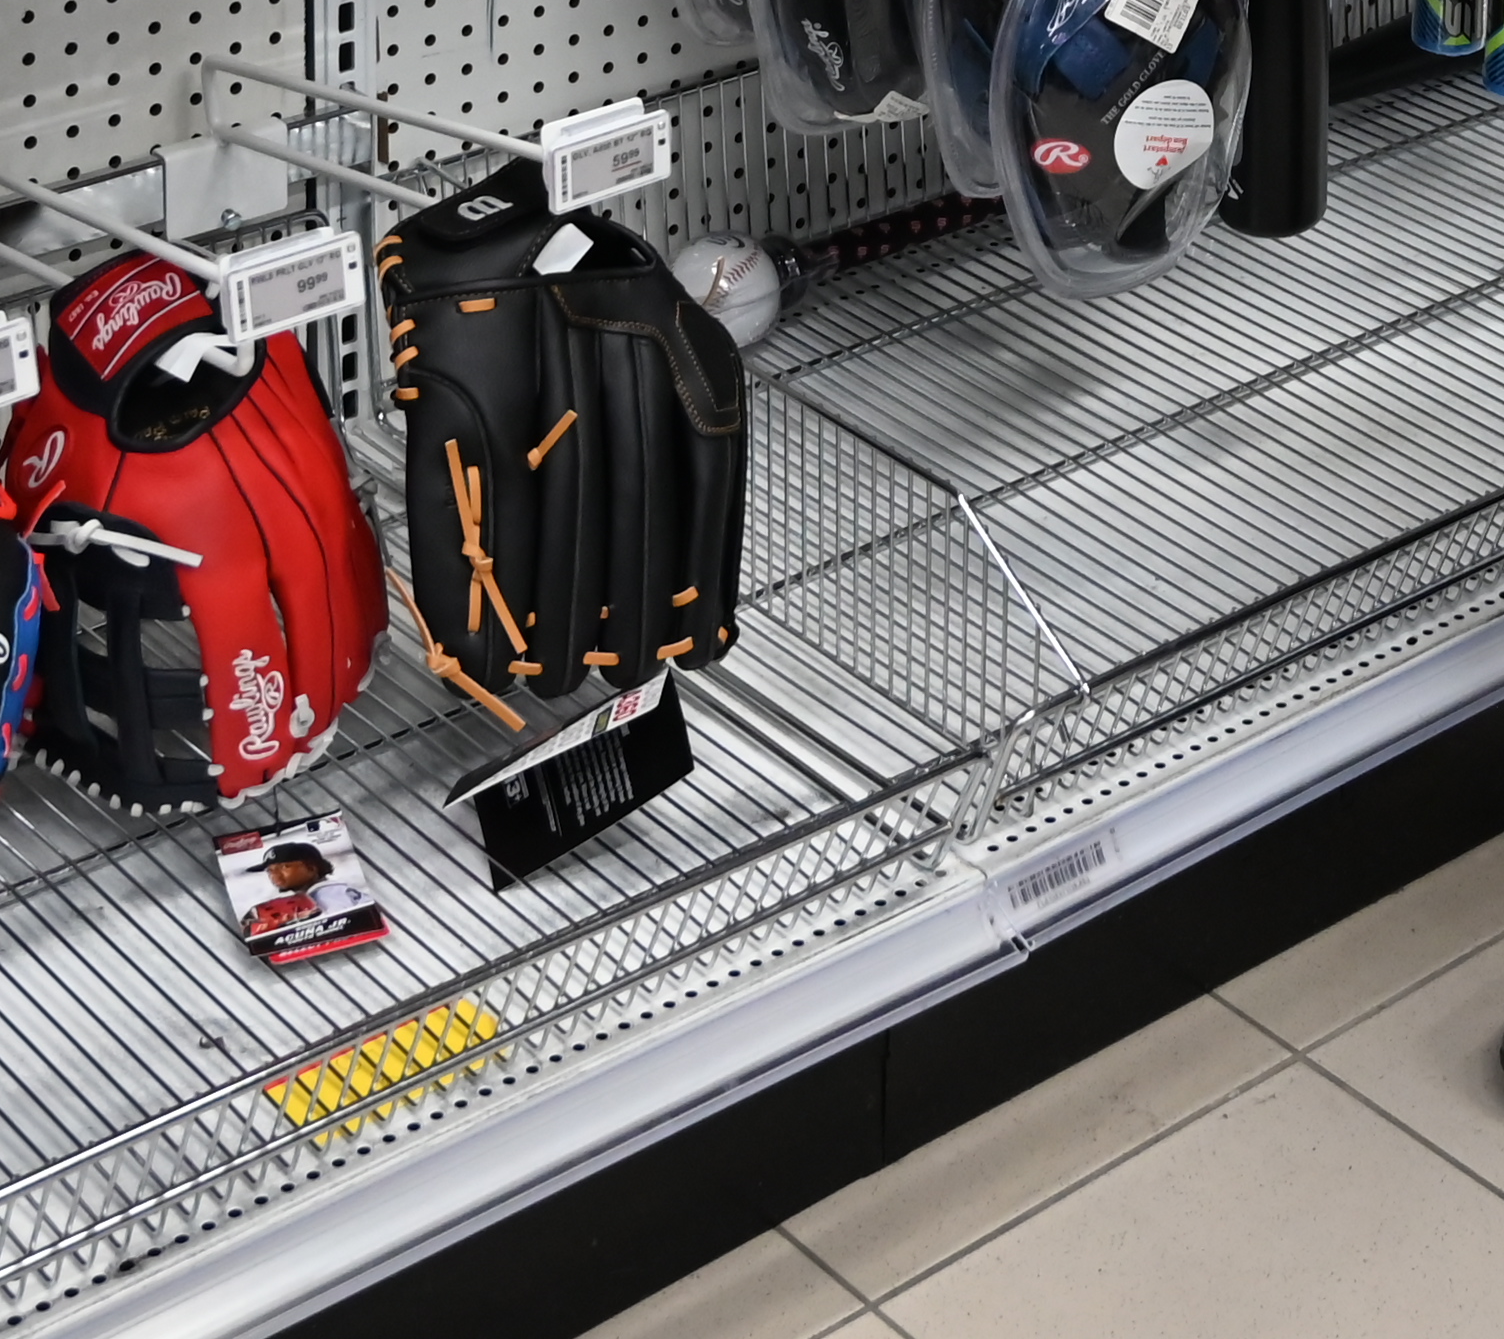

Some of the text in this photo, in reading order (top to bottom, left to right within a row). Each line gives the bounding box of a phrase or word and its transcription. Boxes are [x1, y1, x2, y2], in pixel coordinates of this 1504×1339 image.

[1099, 51, 1167, 126] THE GOLD GLOVE
[229, 647, 270, 762] Rawlings
